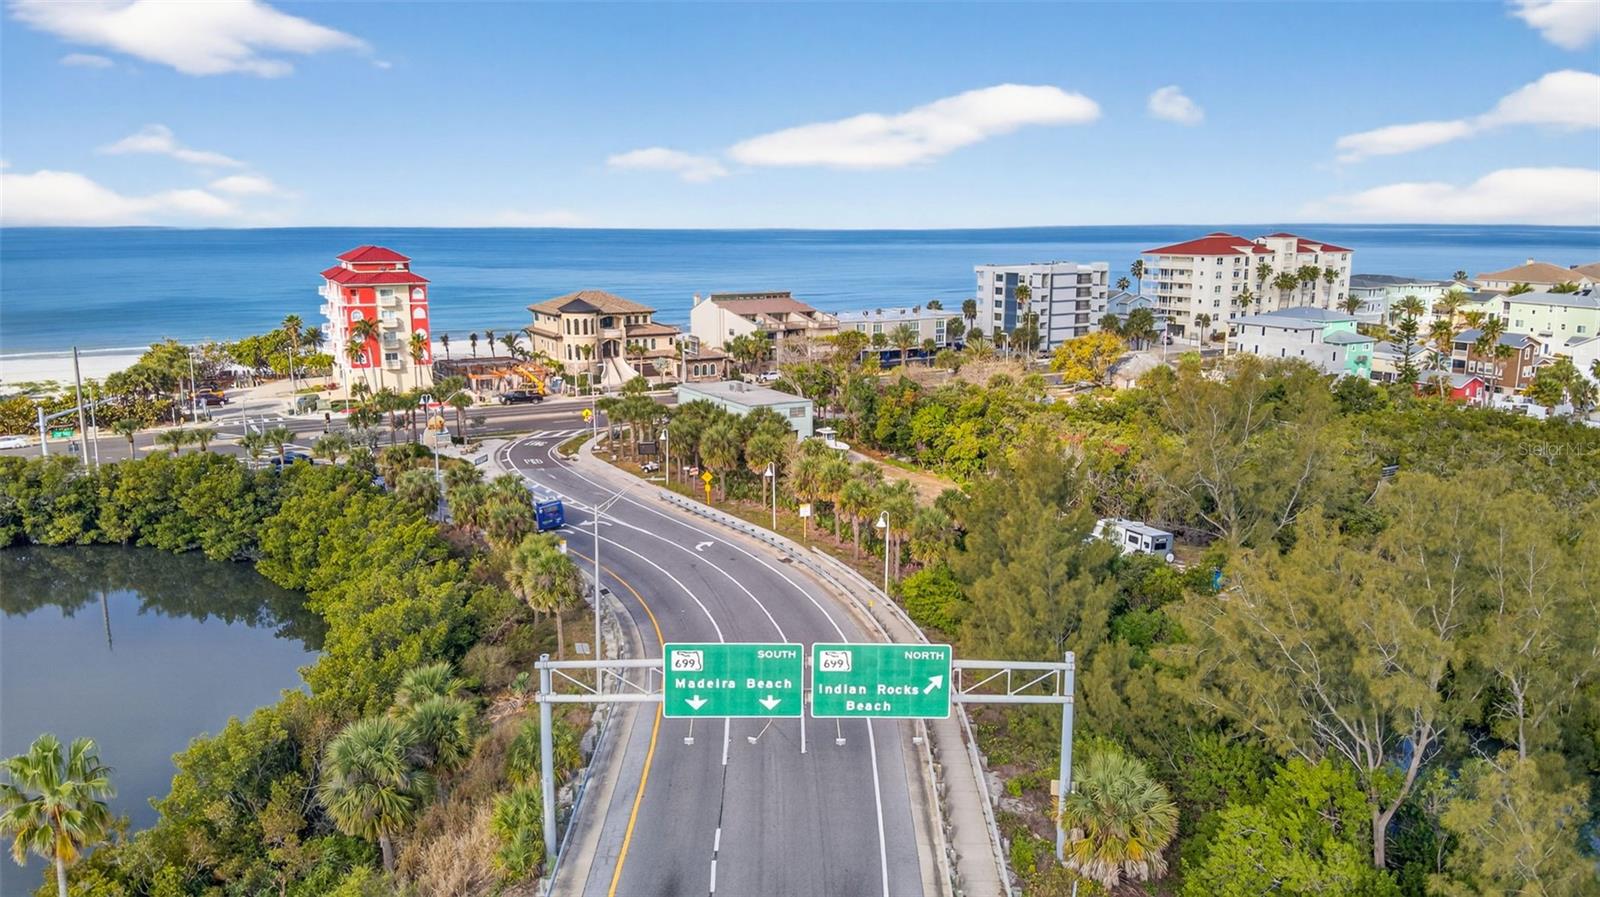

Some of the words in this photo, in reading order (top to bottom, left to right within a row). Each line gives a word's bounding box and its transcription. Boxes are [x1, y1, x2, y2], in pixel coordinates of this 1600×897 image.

[757, 650, 796, 659] SOUTH
[904, 651, 944, 660] NORTH
[674, 659, 695, 668] 699
[823, 659, 844, 668] 699
[675, 678, 736, 689] Madeira
[746, 678, 792, 689] Beach
[818, 683, 867, 695] Indian
[877, 683, 919, 695] Rocks
[846, 700, 891, 711] Beach
